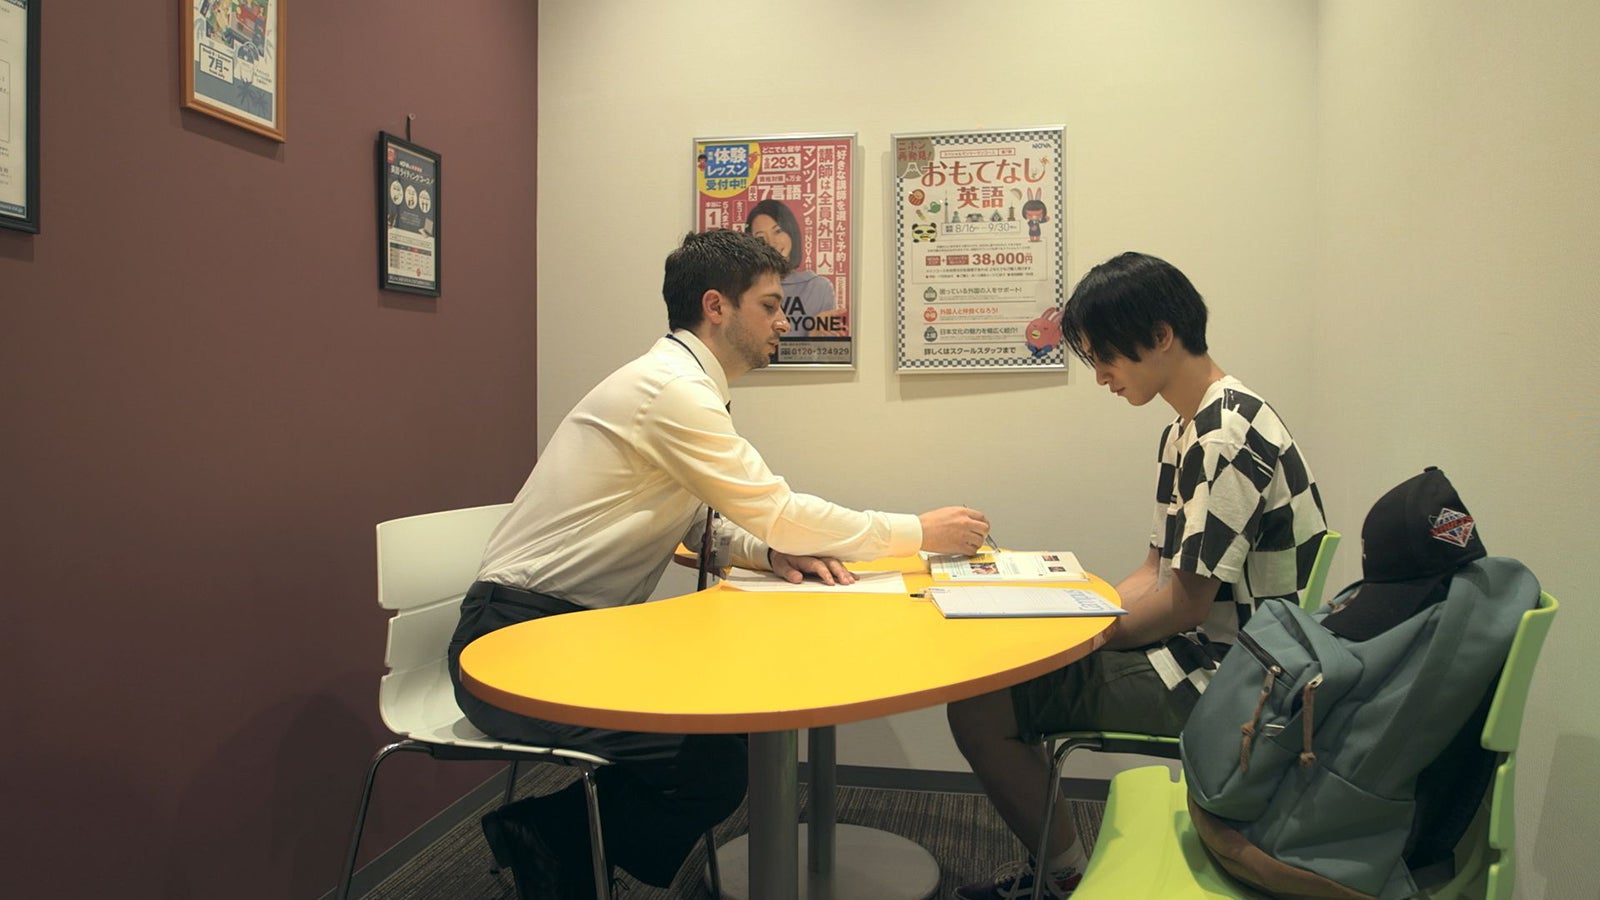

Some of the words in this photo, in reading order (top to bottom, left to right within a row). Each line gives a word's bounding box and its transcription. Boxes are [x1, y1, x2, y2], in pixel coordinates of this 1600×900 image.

[707, 165, 748, 176] レッスン
[921, 157, 1047, 187] おもてなし
[957, 186, 1004, 209] 英語
[924, 346, 1016, 356] 詳しくはスクールスタッフまで
